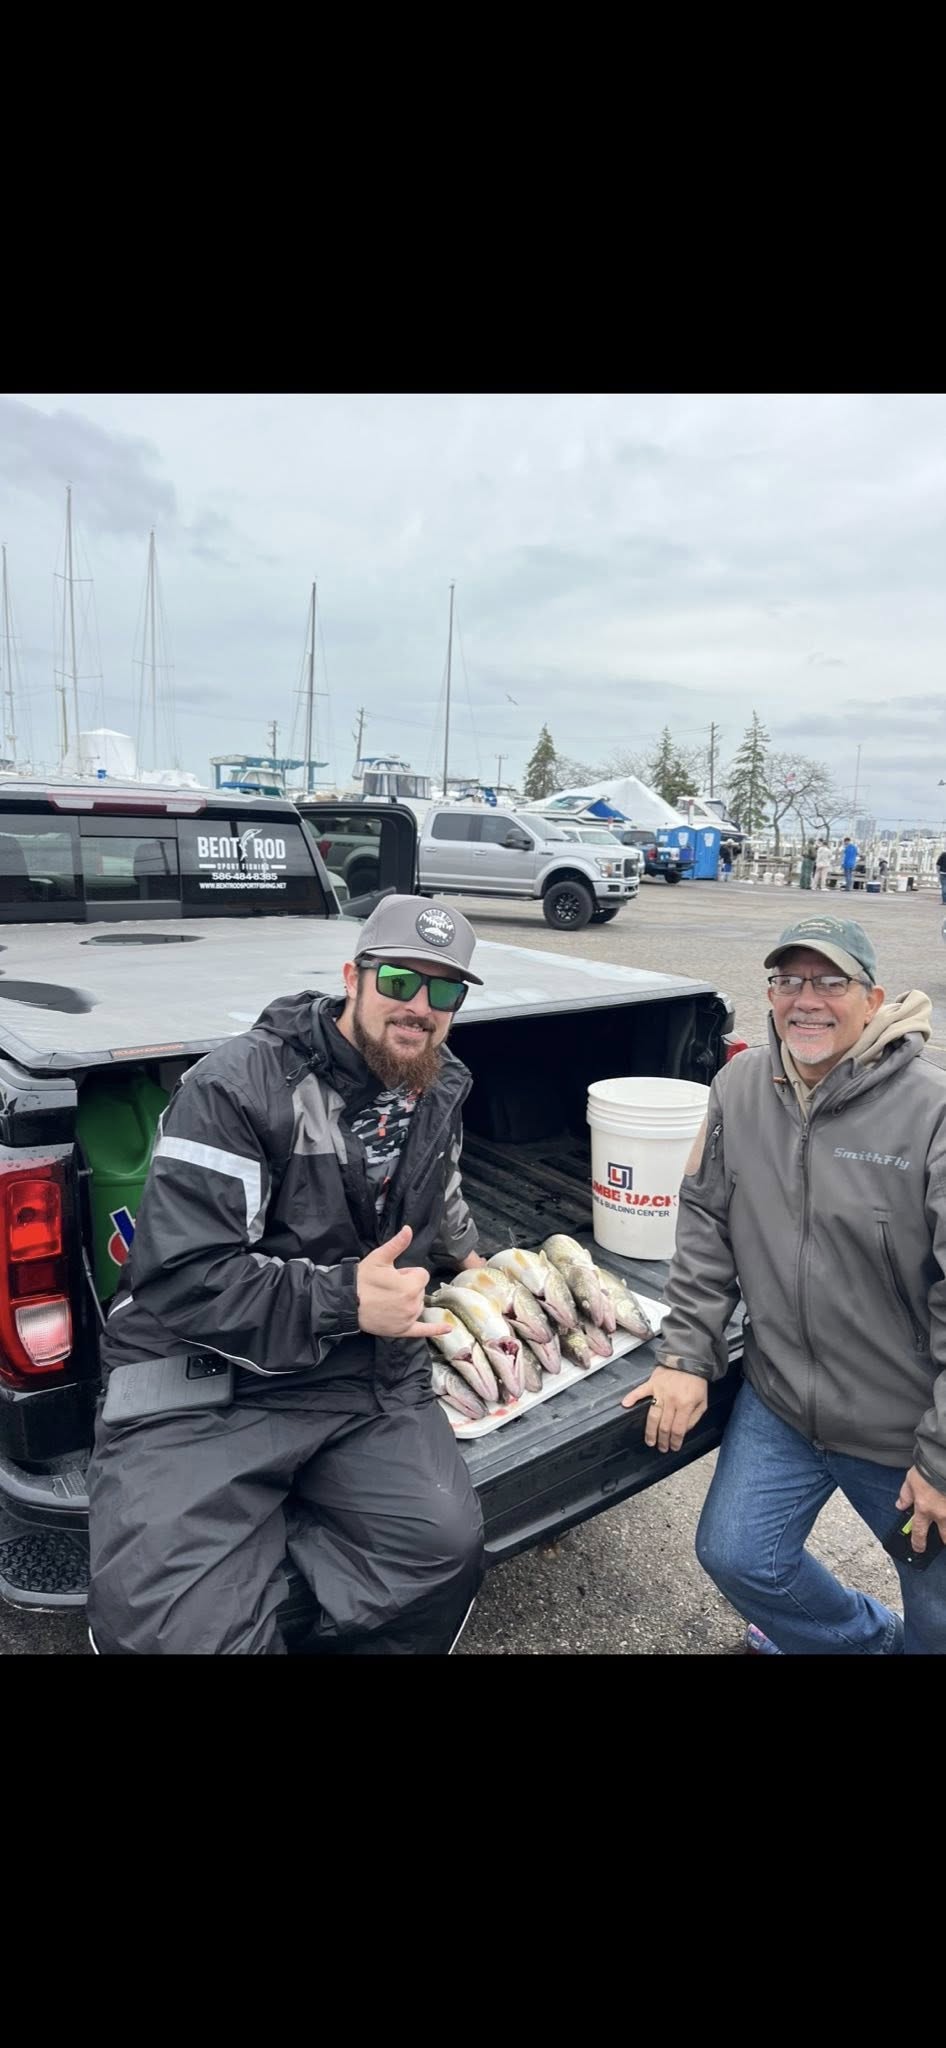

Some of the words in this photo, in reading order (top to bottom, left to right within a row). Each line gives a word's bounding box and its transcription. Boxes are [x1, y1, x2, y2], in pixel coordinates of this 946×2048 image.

[197, 836, 240, 858] BENT
[253, 838, 286, 859] ROD
[833, 1147, 910, 1170] SmithFly
[605, 1202, 636, 1216] BUILDING
